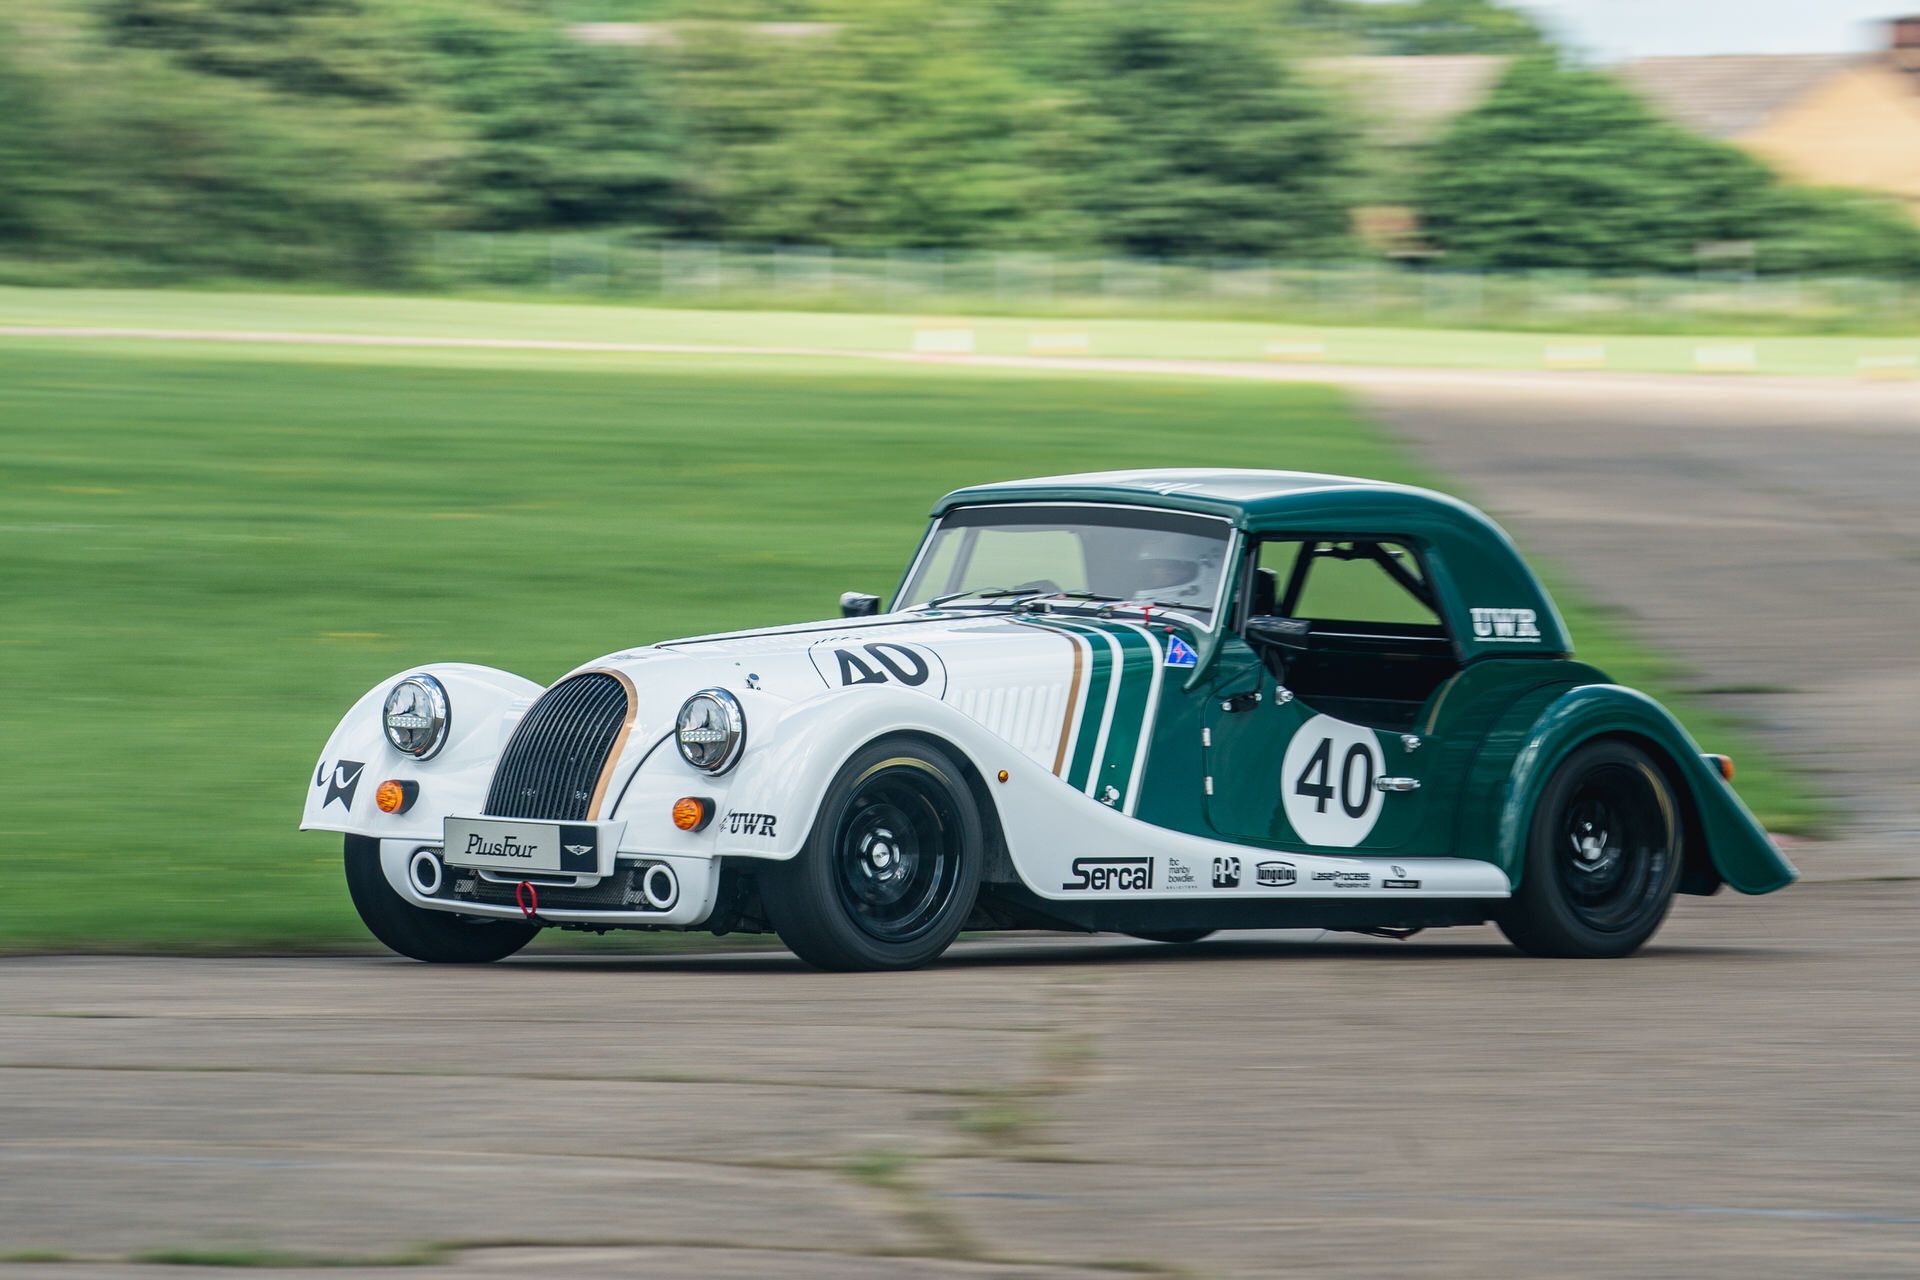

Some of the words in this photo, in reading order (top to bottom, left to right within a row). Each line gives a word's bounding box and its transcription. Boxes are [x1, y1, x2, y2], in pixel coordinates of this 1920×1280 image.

[1469, 608, 1541, 637] UWR
[834, 643, 929, 687] 40
[1295, 737, 1374, 819] 40
[730, 812, 777, 838] UWR
[1062, 856, 1154, 890] Sercal
